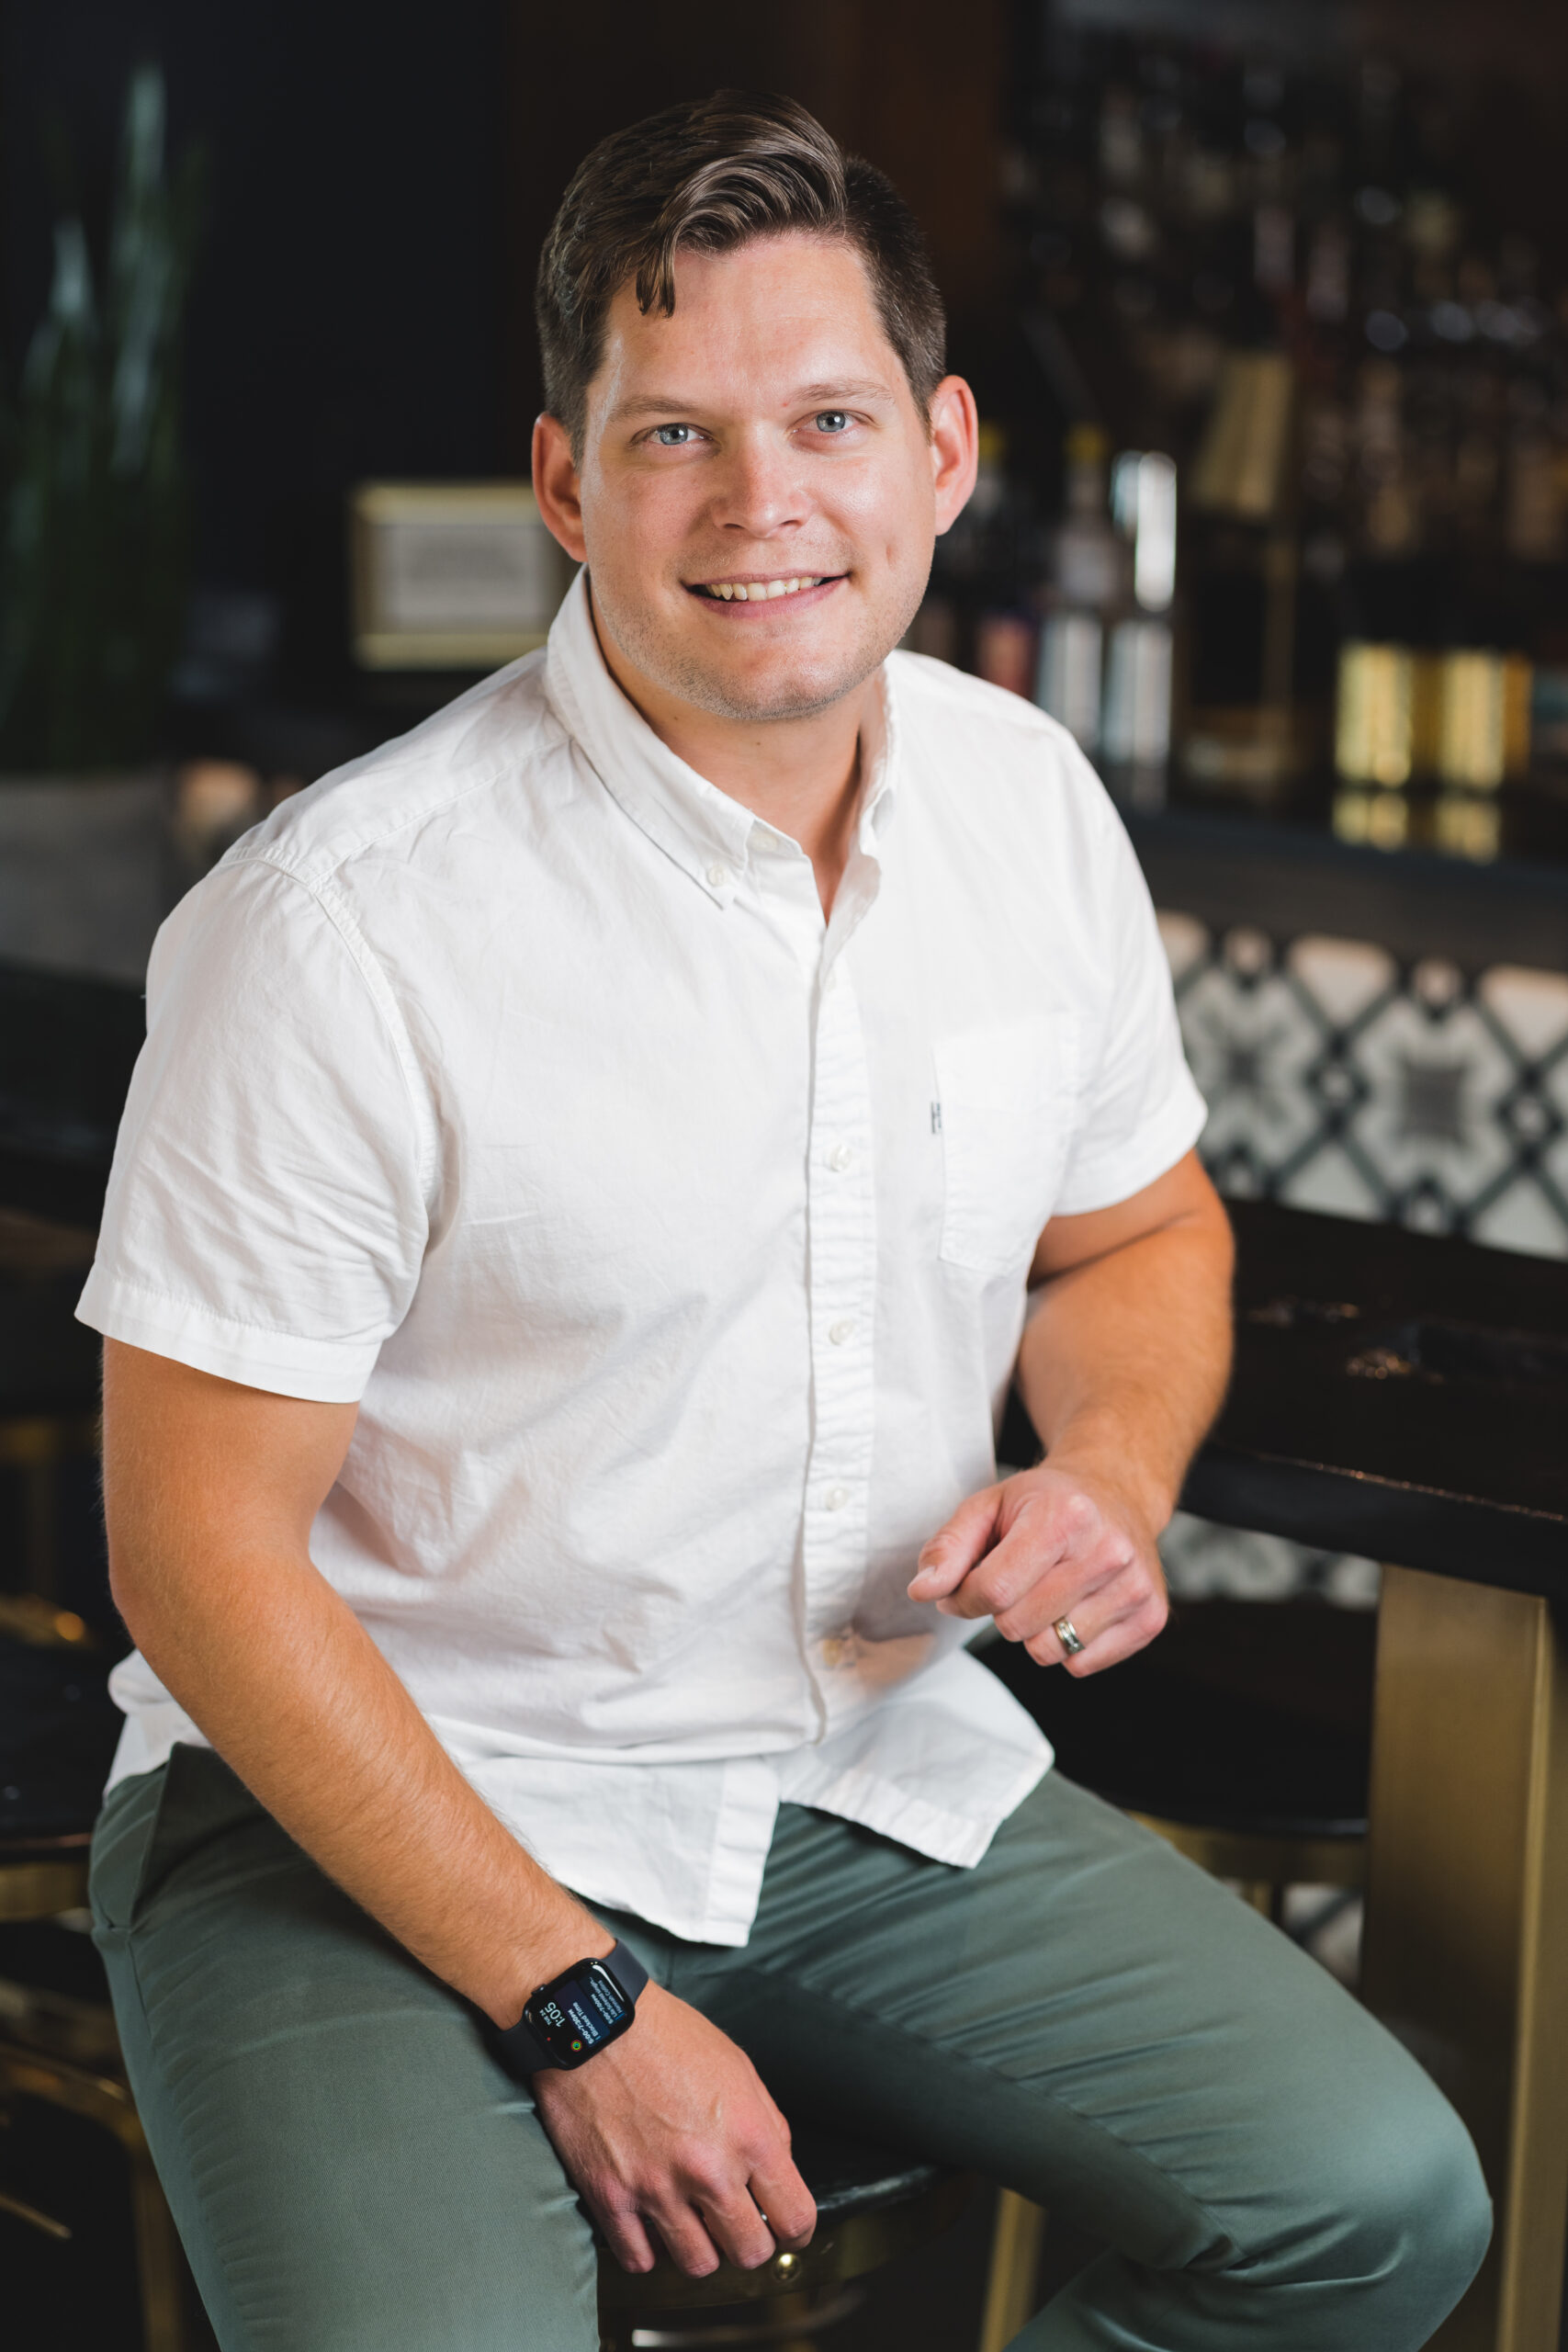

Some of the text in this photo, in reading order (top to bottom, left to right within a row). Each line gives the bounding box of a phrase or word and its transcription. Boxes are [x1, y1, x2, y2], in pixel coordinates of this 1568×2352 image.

[543, 2015, 552, 2026] TUE
[544, 2002, 566, 2028] 1:05
[572, 2002, 599, 2037] Blocked Time
